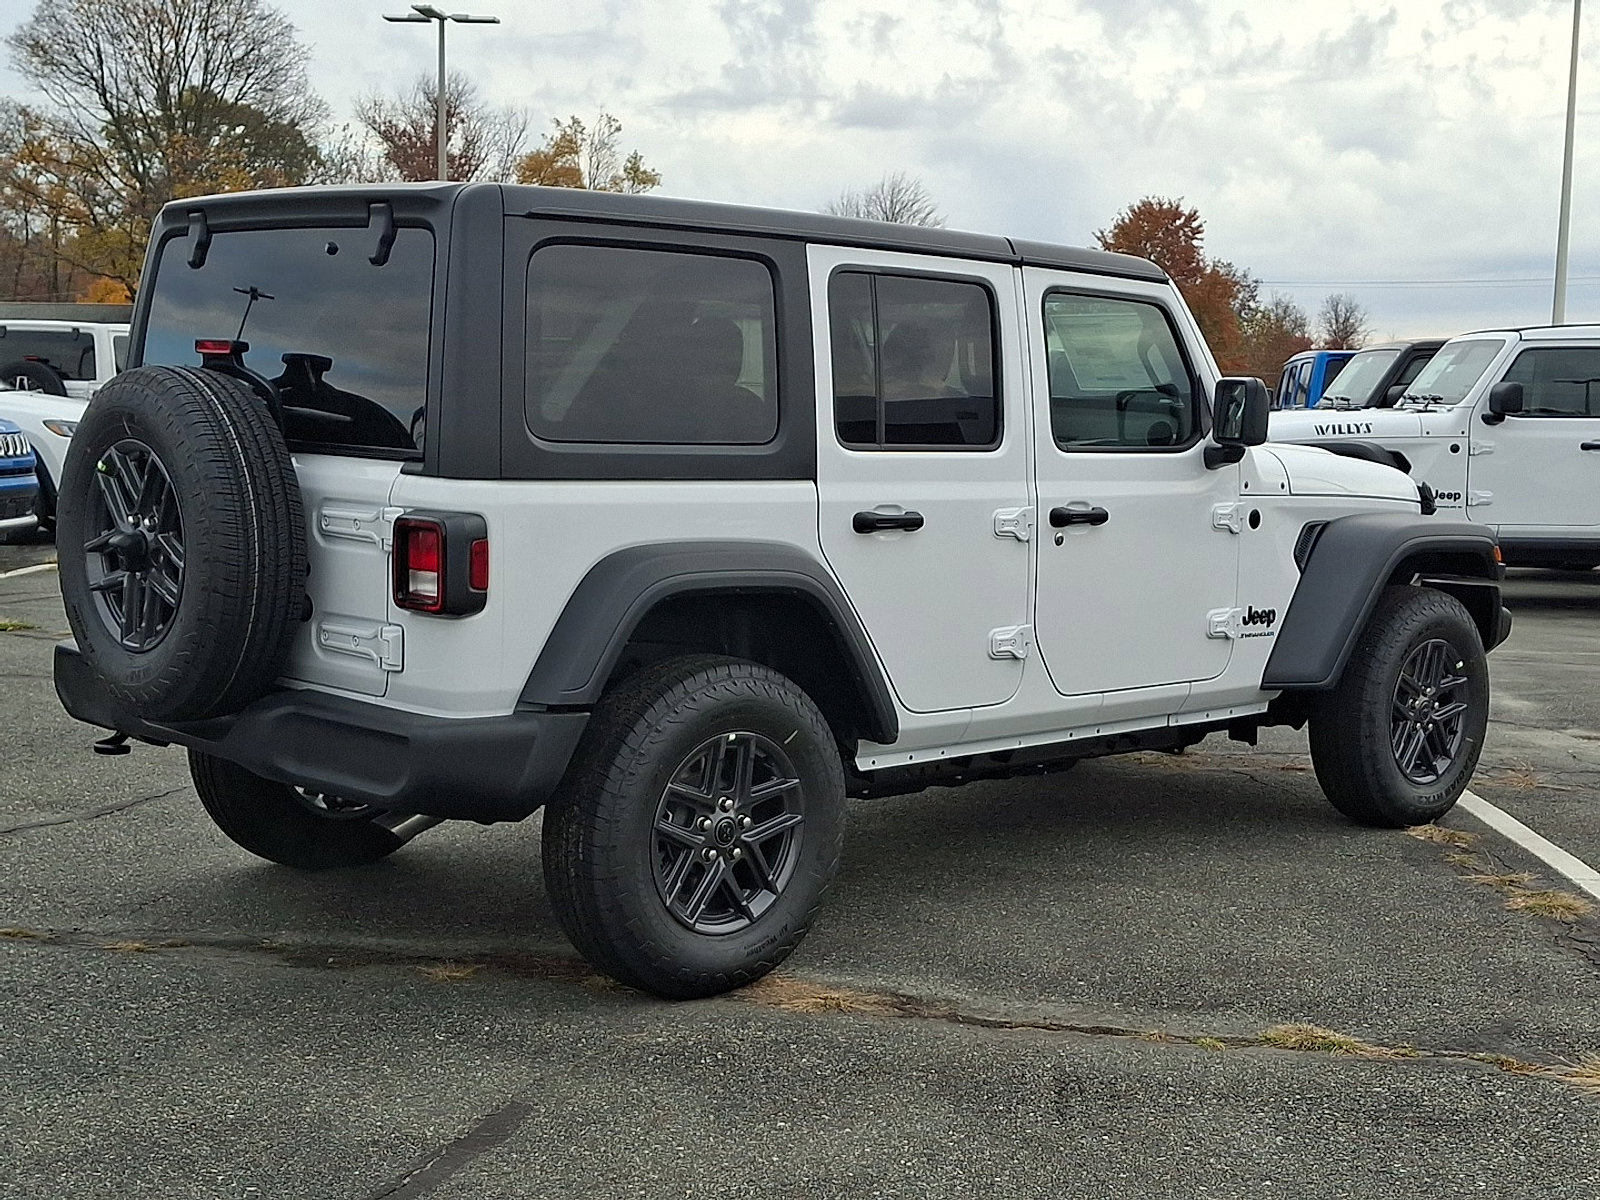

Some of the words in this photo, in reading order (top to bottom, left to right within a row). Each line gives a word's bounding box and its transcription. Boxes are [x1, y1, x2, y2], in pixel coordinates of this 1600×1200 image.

[1314, 422, 1373, 435] WILLYS
[1434, 489, 1462, 502] Jeep
[1242, 605, 1276, 628] Jeep
